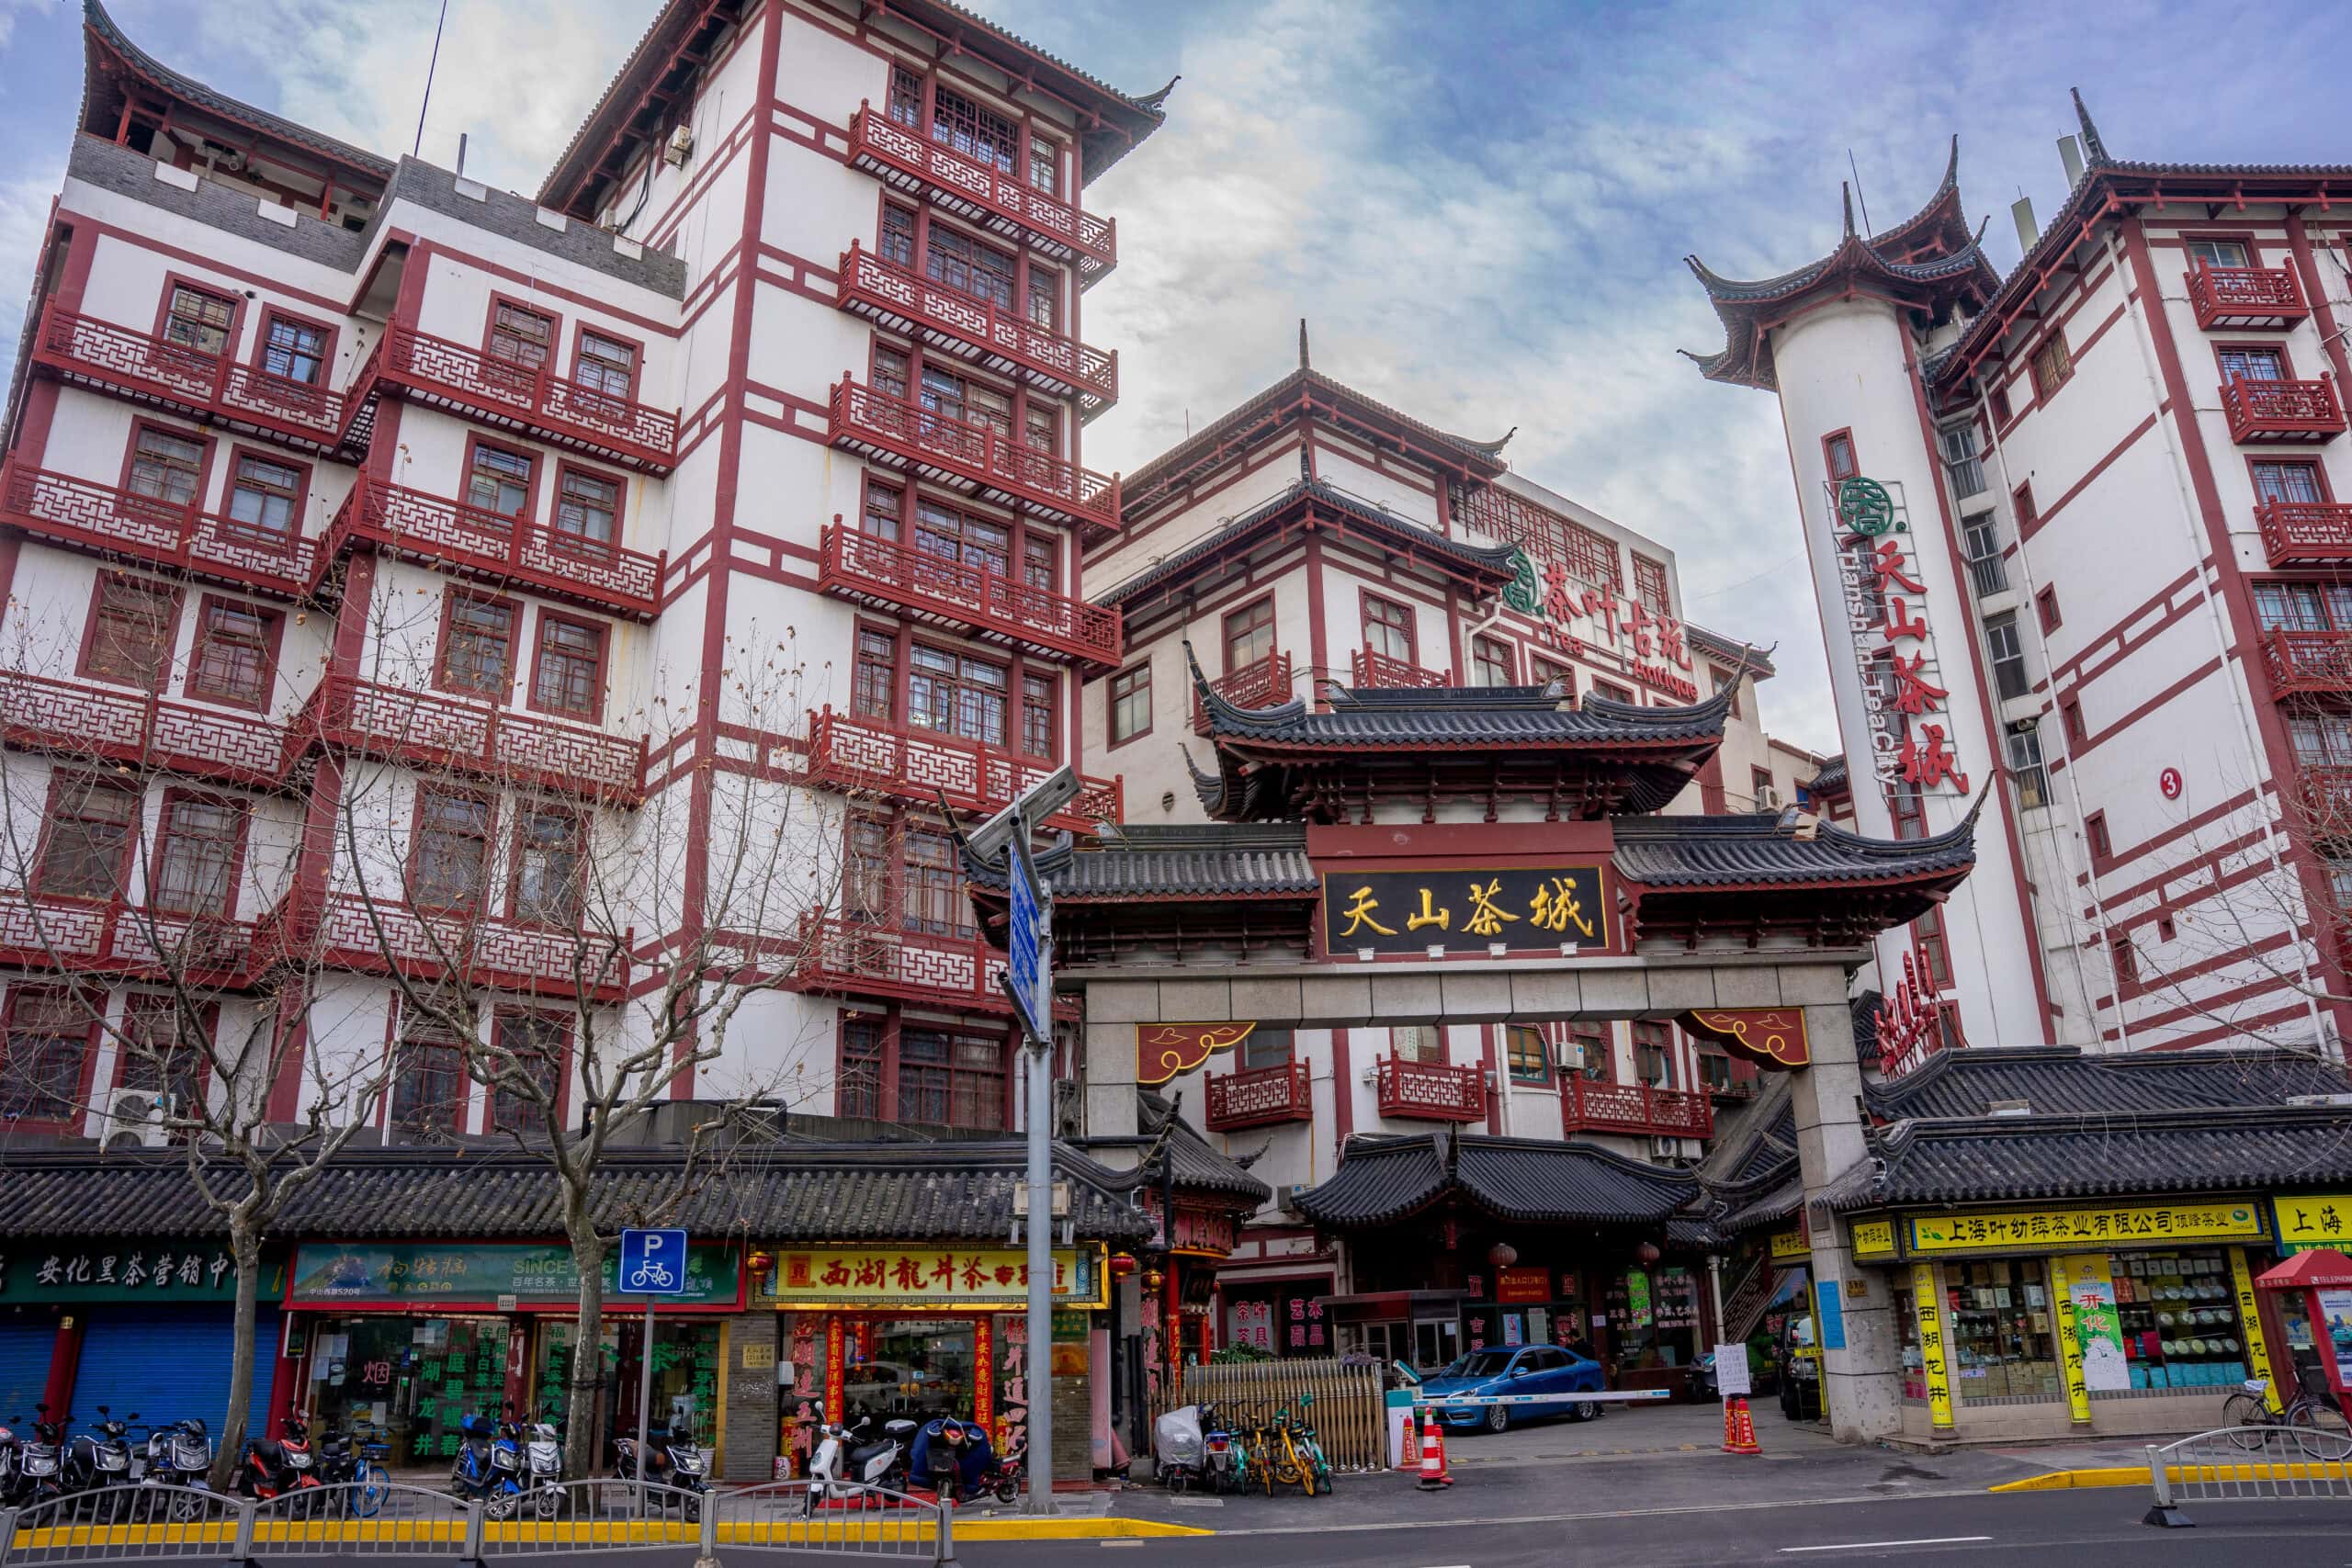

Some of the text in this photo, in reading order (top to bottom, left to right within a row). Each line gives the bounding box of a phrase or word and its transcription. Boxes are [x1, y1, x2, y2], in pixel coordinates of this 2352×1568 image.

[1544, 561, 1615, 648] 茶叶
[1622, 599, 1692, 671] 古玩
[1545, 621, 1698, 701] Tea Antique
[1871, 540, 1970, 795] 天山茶城
[2164, 773, 2177, 795] 3
[1339, 877, 1595, 939] 天山茶城
[2293, 1205, 2343, 1235] 上海
[644, 1235, 662, 1257] P
[36, 1250, 241, 1289] 安化黑茶营销中
[514, 1259, 568, 1274] SINCE
[1236, 1300, 1267, 1323] 茶叶
[1237, 1326, 1269, 1347] 茶具
[2059, 1299, 2086, 1398] 西湖龙井
[1919, 1306, 1948, 1403] 西湖龙井
[361, 1360, 390, 1384] 烟
